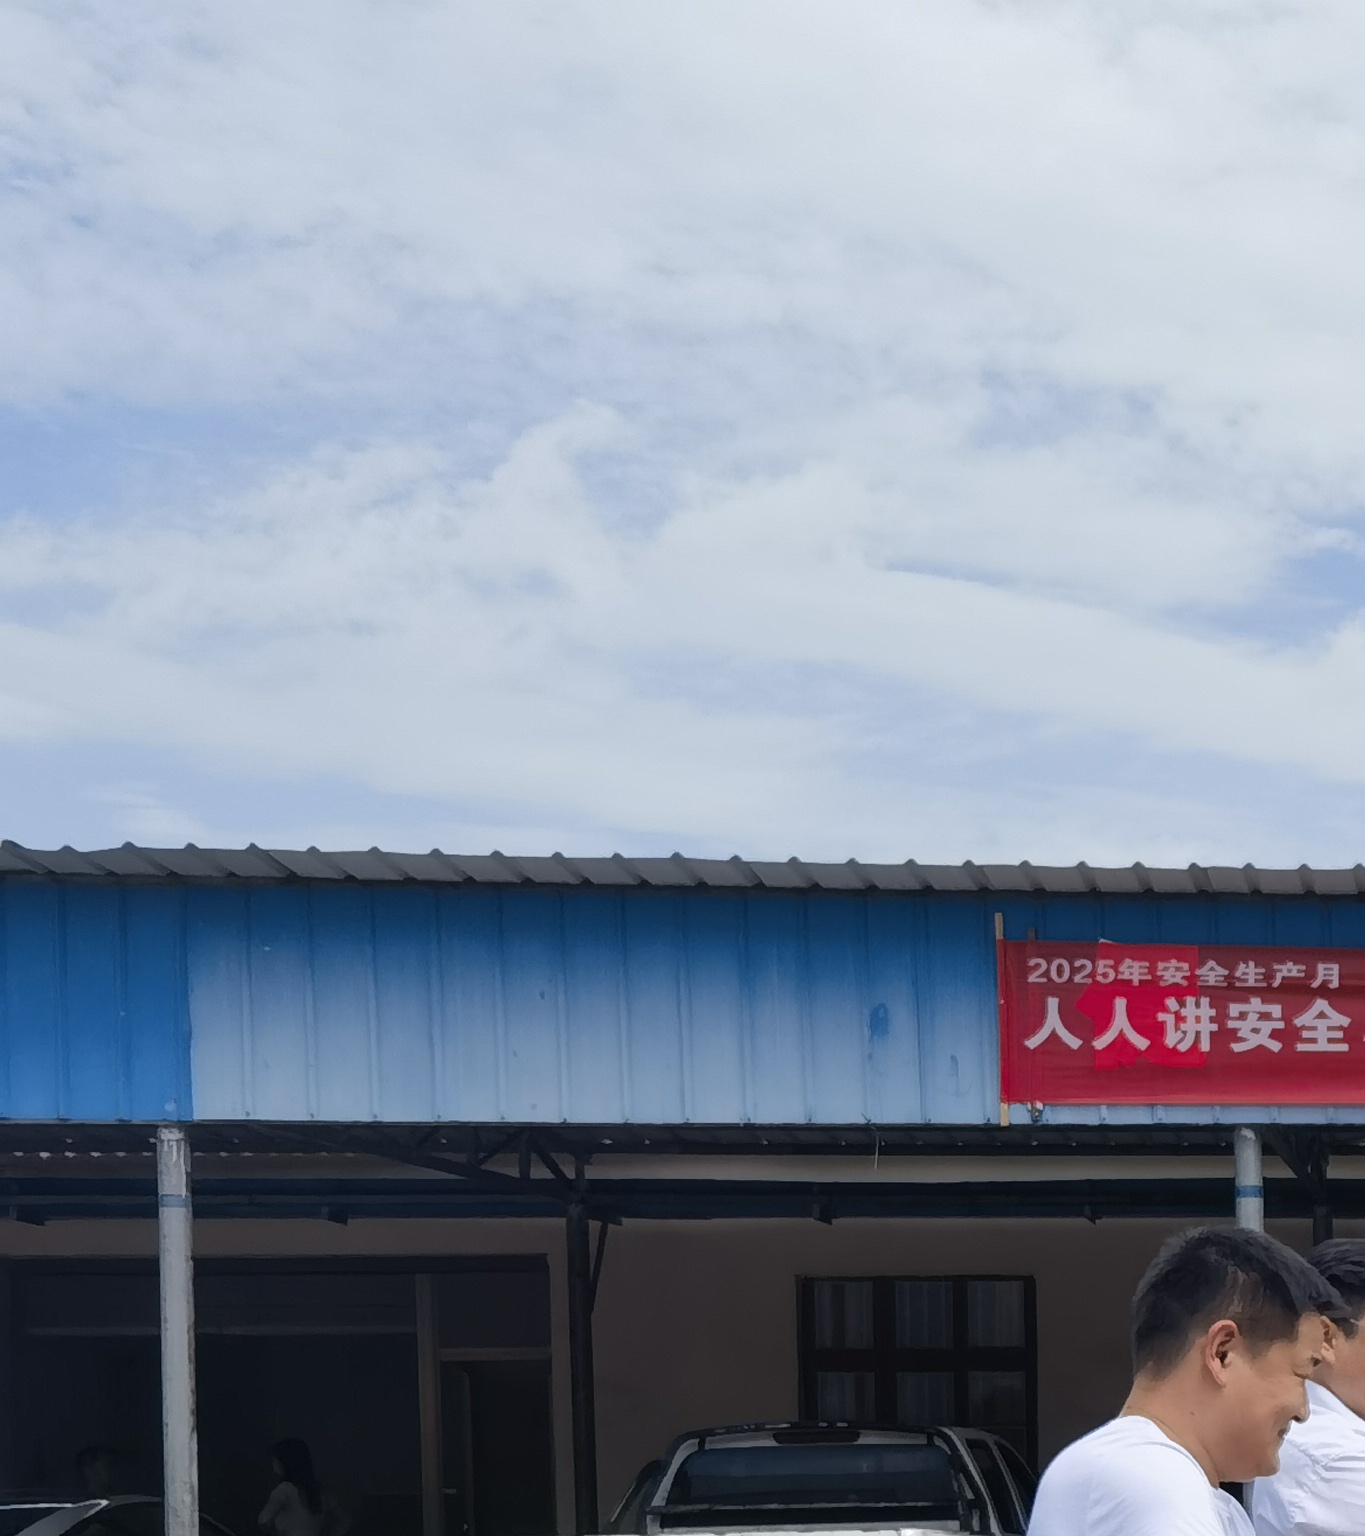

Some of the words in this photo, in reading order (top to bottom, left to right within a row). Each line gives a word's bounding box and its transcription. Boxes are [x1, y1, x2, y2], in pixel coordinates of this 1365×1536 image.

[1027, 957, 1341, 989] 2025年安全生产月
